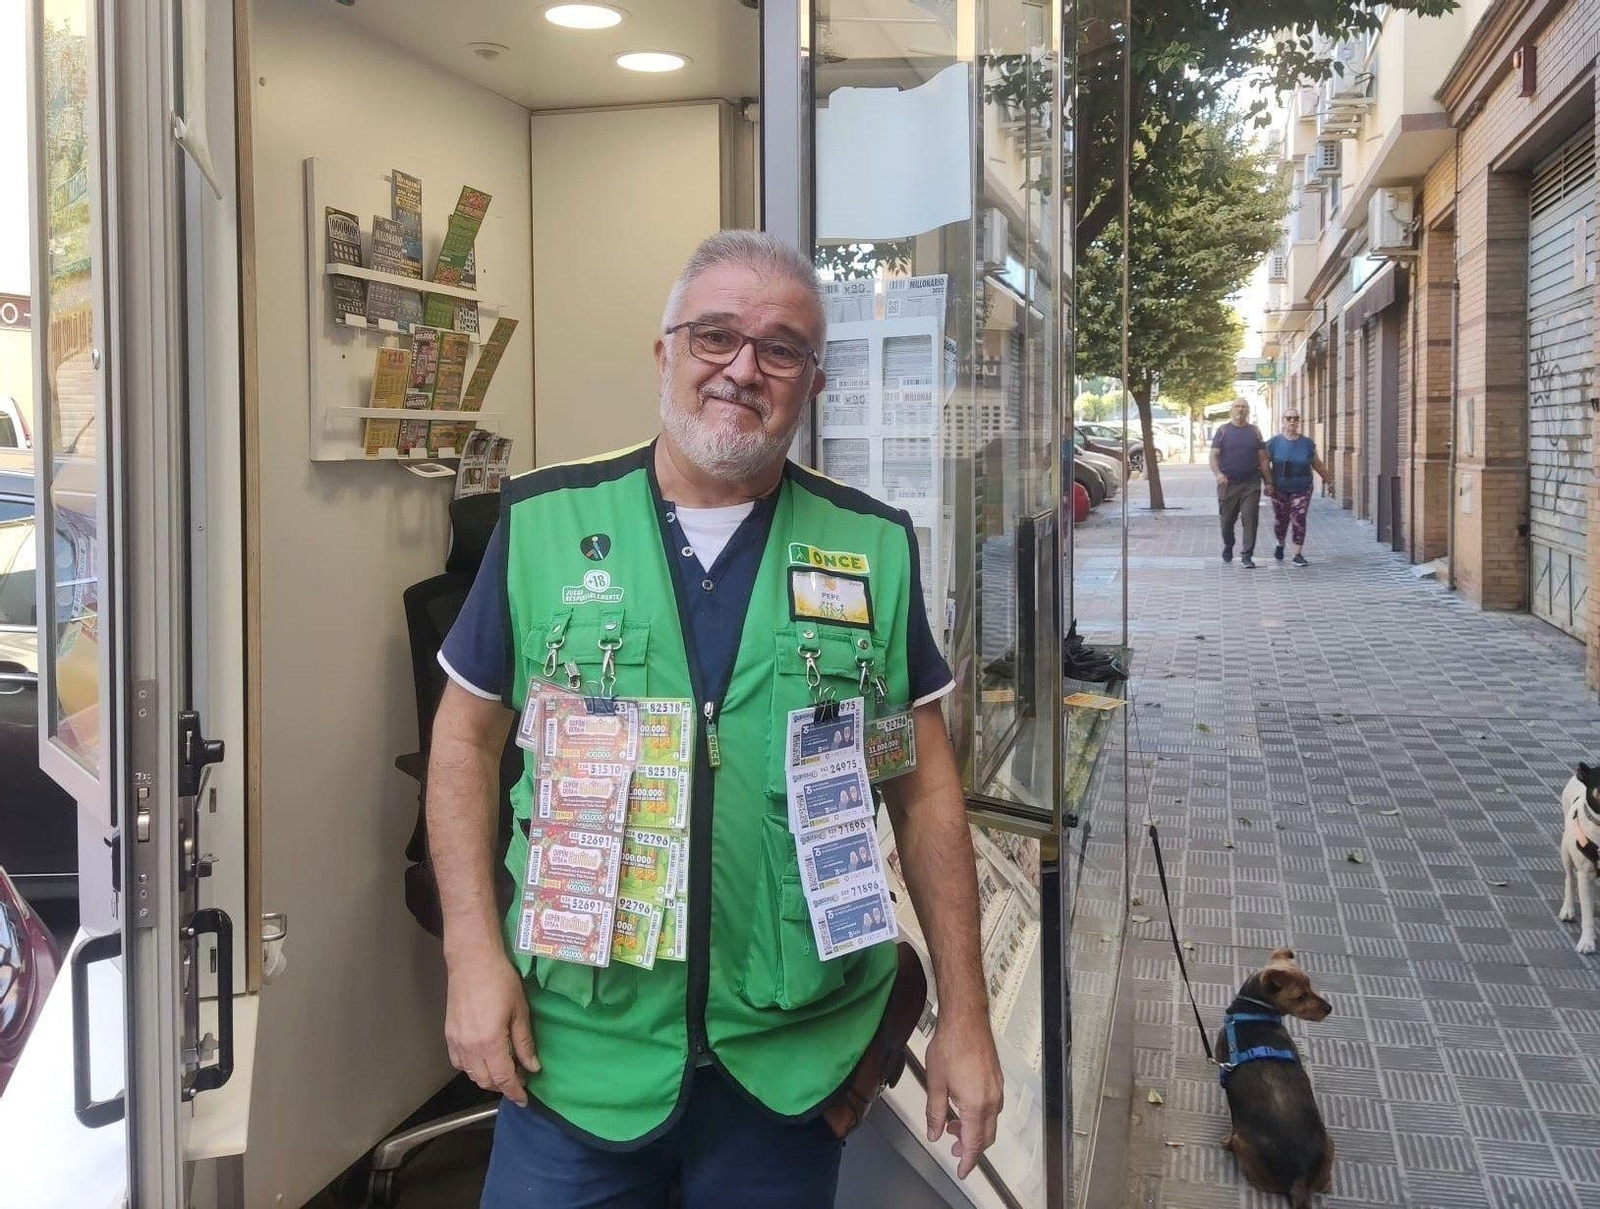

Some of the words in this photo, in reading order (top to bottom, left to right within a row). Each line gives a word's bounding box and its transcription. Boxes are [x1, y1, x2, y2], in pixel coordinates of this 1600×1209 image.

[813, 551, 862, 570] ONCE
[586, 574, 606, 588] +18
[647, 766, 677, 777] 82518
[829, 759, 857, 774] 24975
[838, 819, 866, 836] 71896
[580, 834, 610, 847] 52691
[637, 832, 669, 847] 92796
[850, 882, 880, 897] 71896
[572, 898, 602, 912] 52691
[618, 897, 651, 914] 92796
